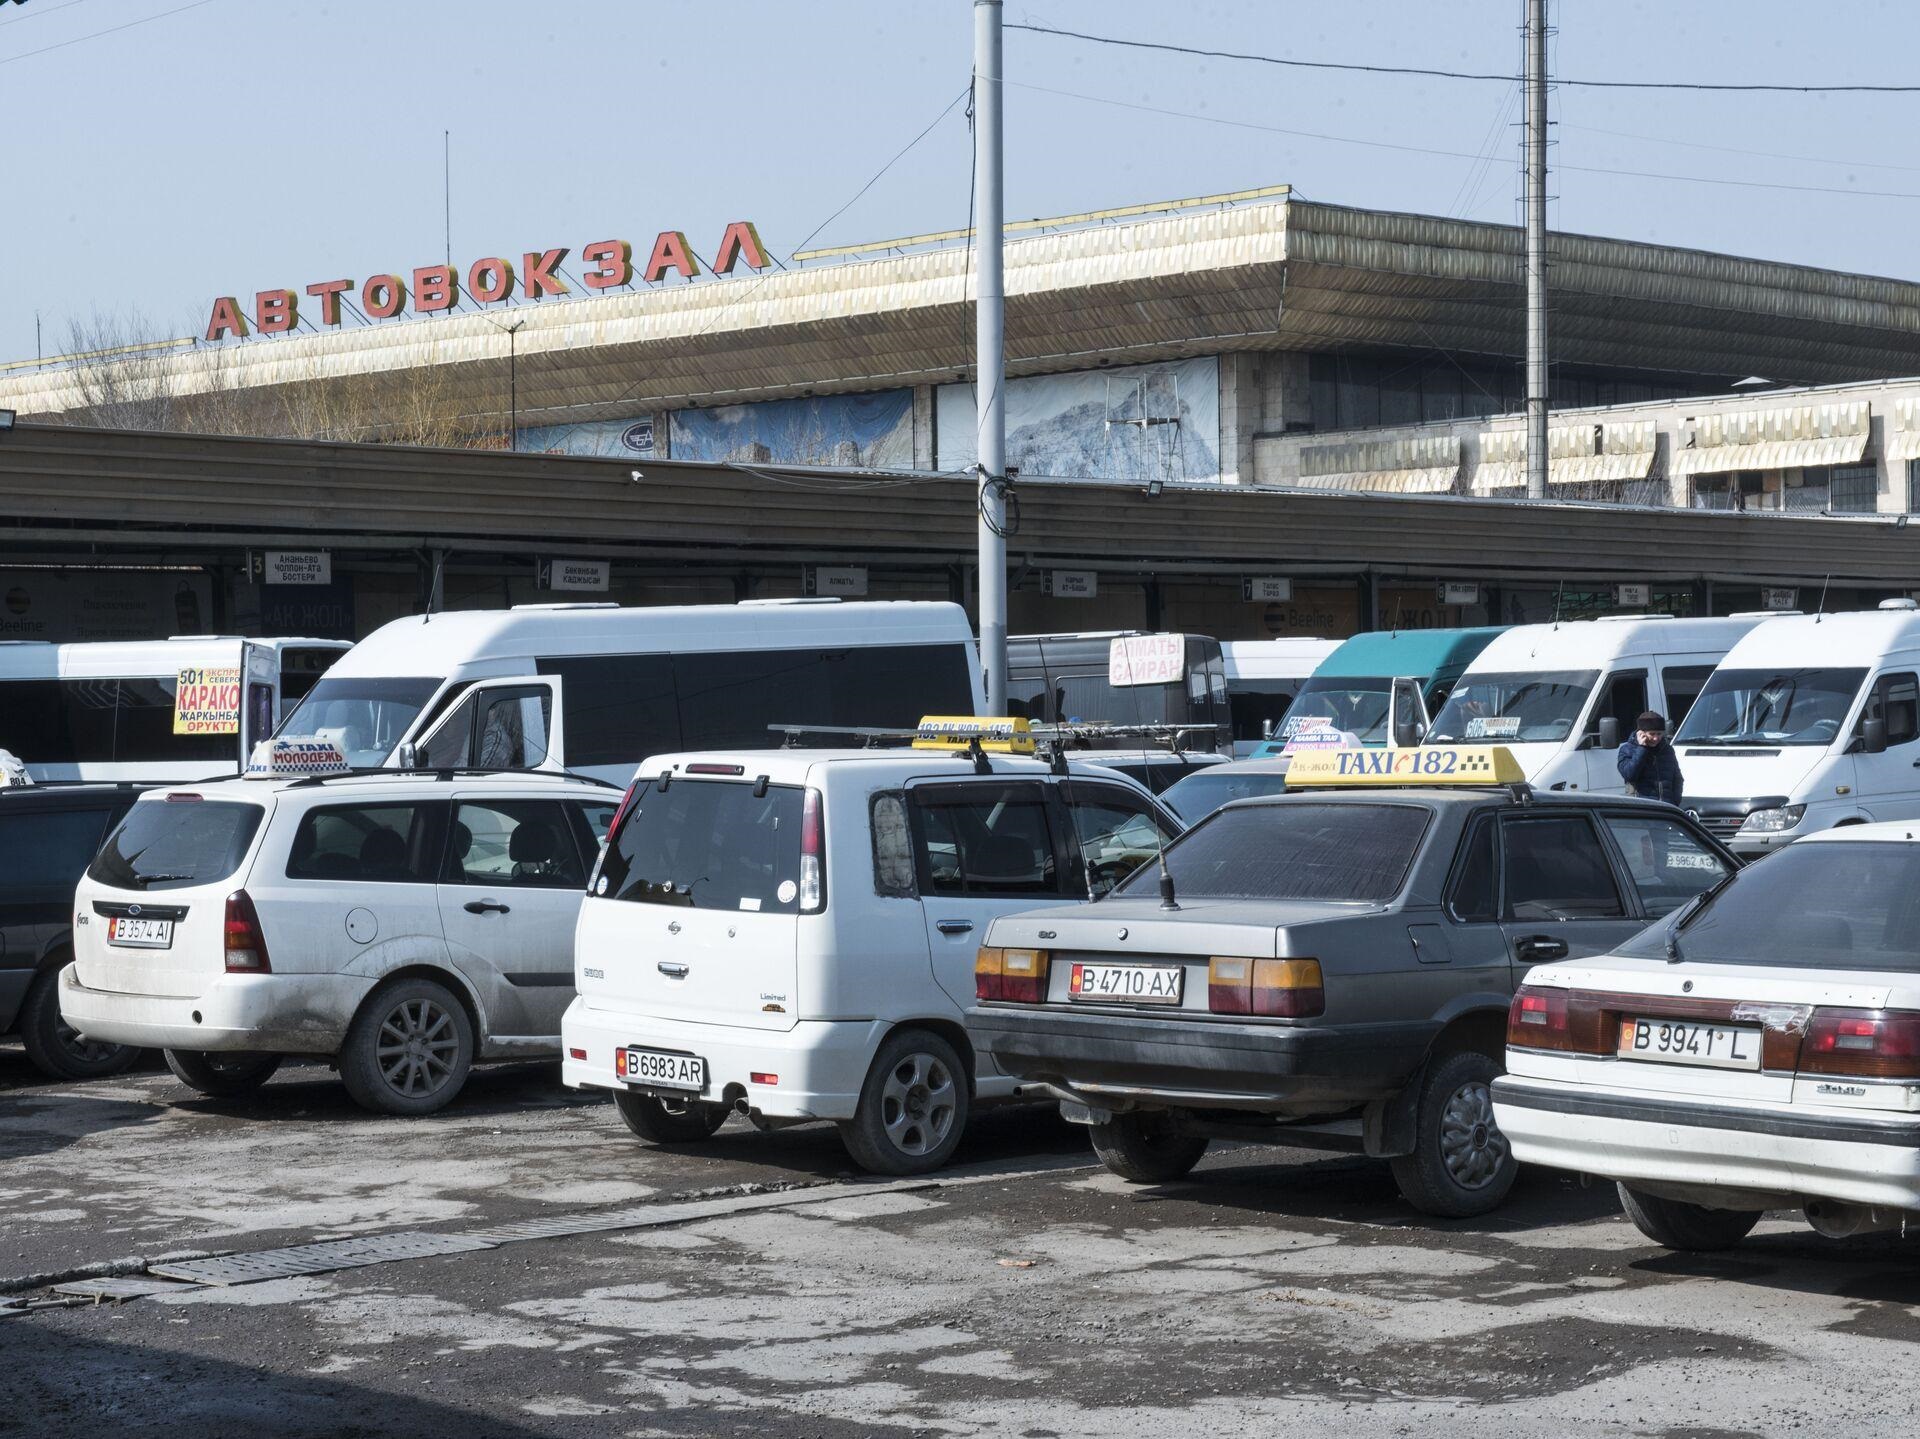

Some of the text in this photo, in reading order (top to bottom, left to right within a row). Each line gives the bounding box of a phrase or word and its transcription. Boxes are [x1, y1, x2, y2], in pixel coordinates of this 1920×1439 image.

[205, 221, 772, 340] АВТОВОКЗАЛ
[253, 556, 263, 574] 3
[540, 564, 550, 585] 4
[807, 571, 816, 590] 5
[1244, 583, 1251, 598] 7
[1115, 638, 1180, 658] АЛМАТЫ
[180, 670, 204, 685] 501
[1113, 659, 1180, 682] САЙРАН
[178, 684, 240, 710] КАРАКО
[295, 743, 335, 752] TAXI
[274, 751, 343, 765] МОЛОДЕЖЬ
[1336, 751, 1395, 775] TAXI
[1408, 751, 1457, 774] 182
[118, 919, 126, 937] B
[128, 920, 153, 939] 3574
[1082, 968, 1180, 996] B 4710 AX
[760, 993, 786, 1002] Limited
[1634, 1021, 1747, 1060] B 9941 L
[678, 1060, 701, 1083] AR
